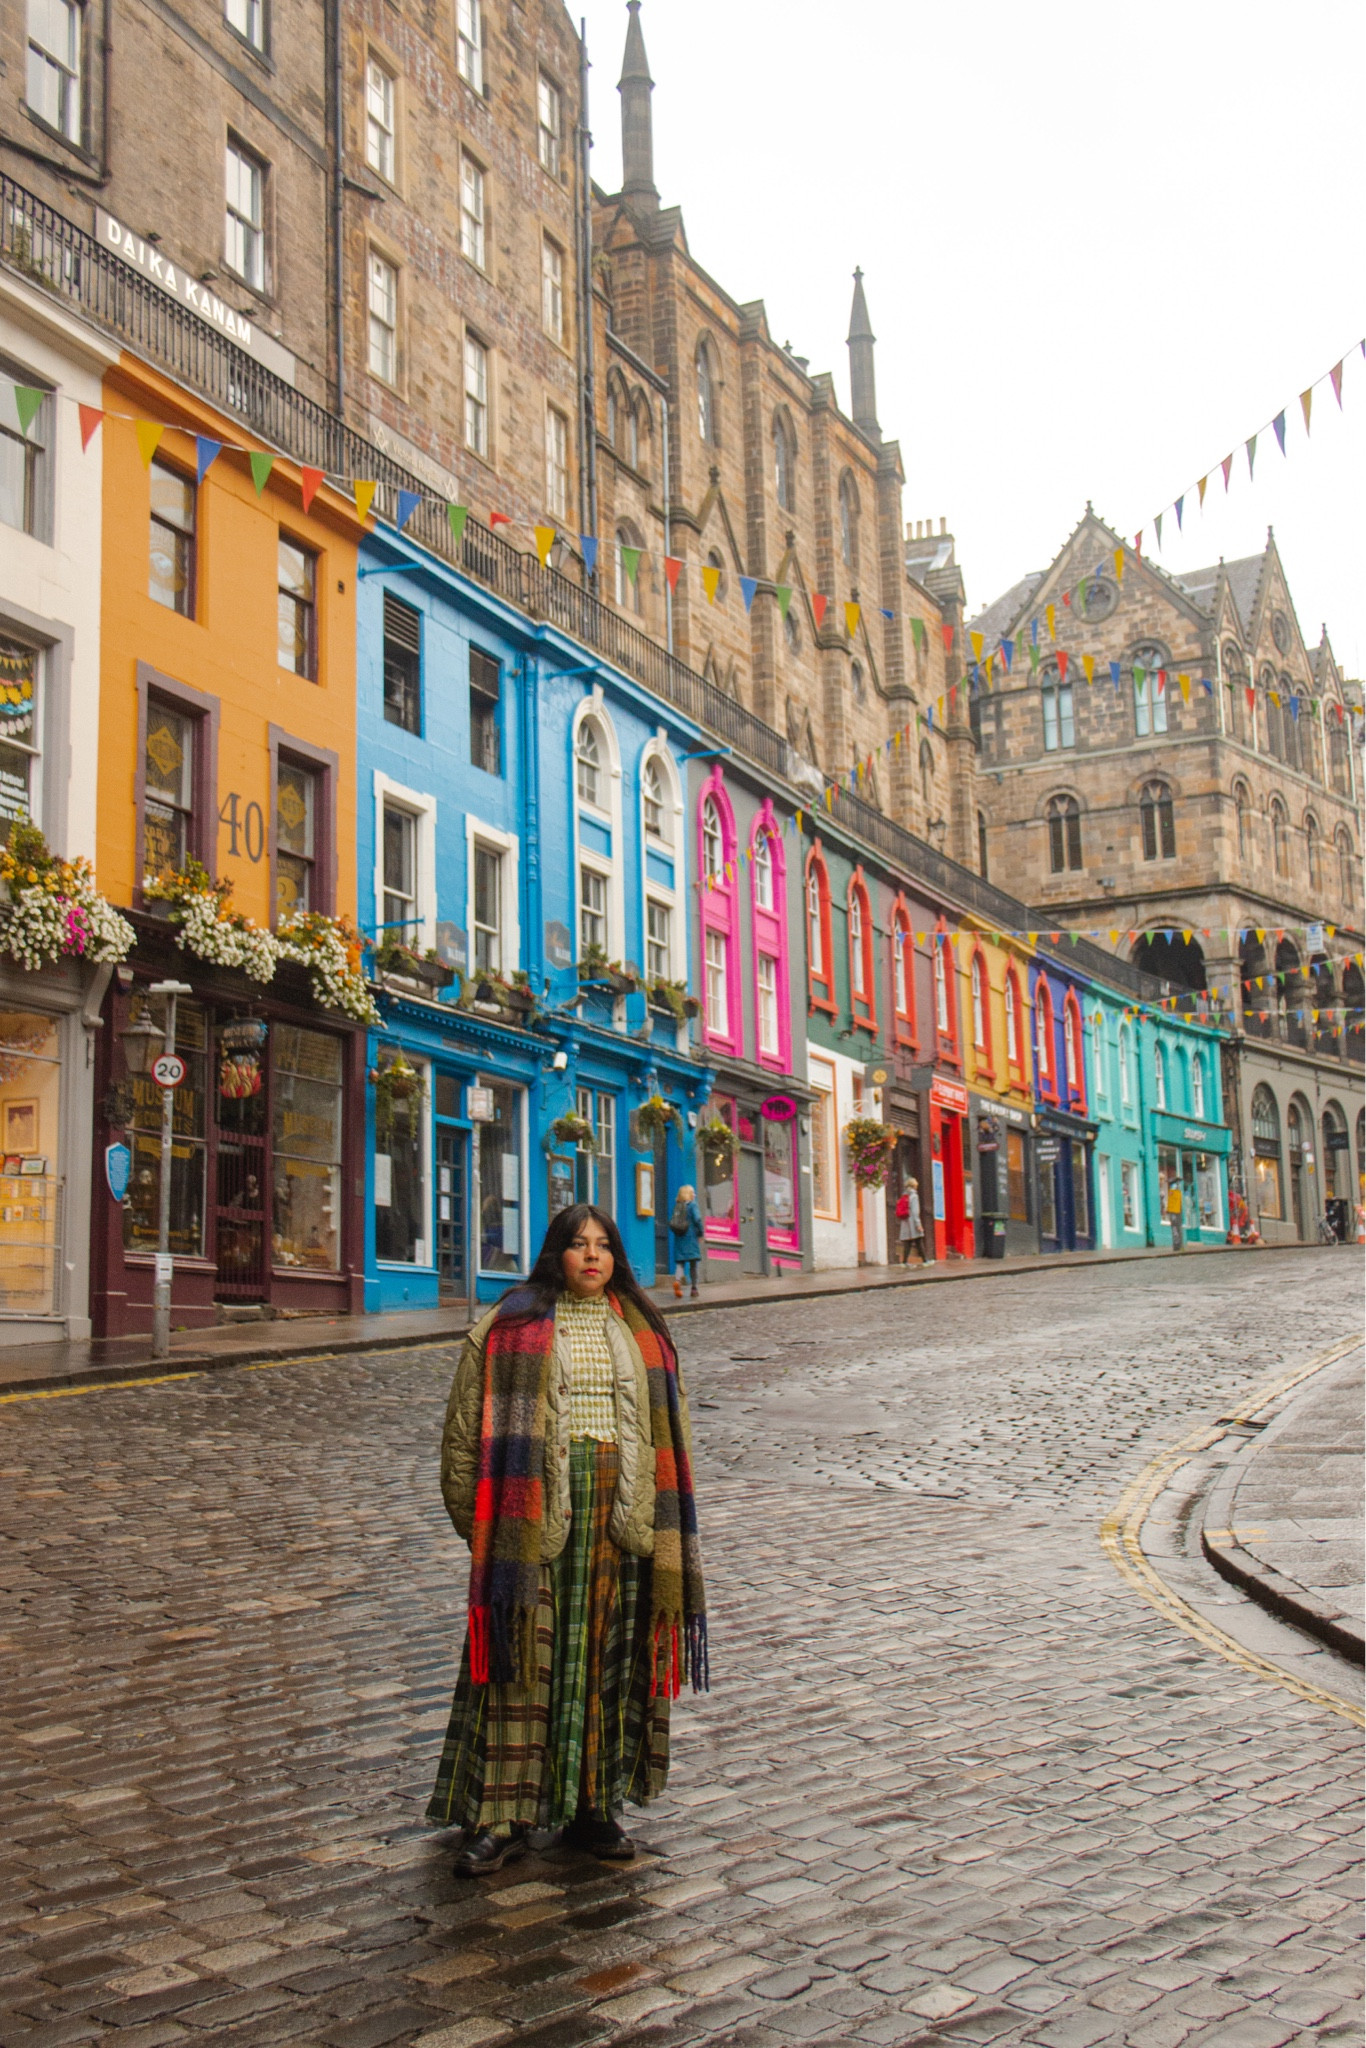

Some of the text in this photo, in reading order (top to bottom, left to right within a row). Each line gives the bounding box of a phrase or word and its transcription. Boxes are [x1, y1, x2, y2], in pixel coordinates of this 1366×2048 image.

[108, 217, 251, 346] DAIKA KANAM
[219, 792, 264, 864] 40
[133, 1077, 194, 1119] MUSUM
[157, 1062, 181, 1079] 20
